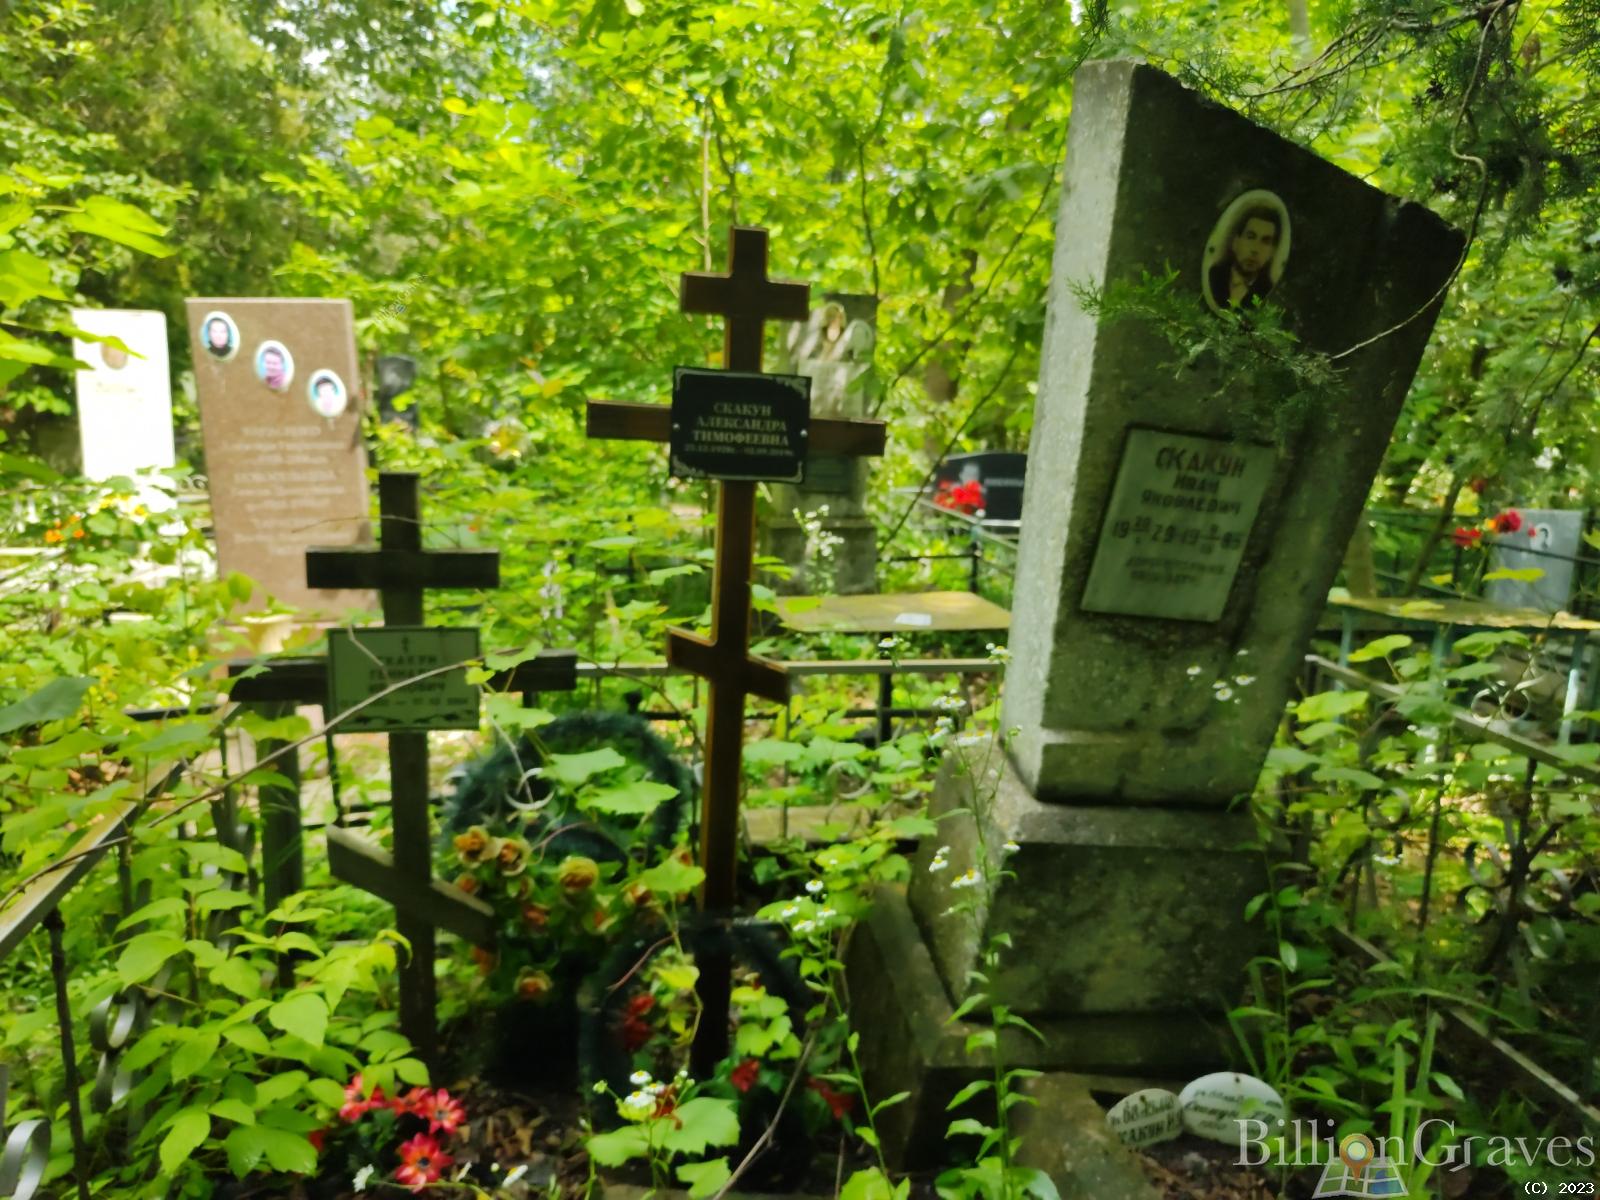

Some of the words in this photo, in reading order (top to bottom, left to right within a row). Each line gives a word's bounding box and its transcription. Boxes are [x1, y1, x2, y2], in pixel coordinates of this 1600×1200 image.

[713, 402, 772, 416] СКАКУН
[696, 416, 788, 432] АЛЕКСАНДРА
[692, 430, 789, 446] ТИМОФЕЕВНА
[1155, 447, 1247, 478] СКАКУН
[1173, 474, 1220, 495] ИВАН
[1141, 488, 1242, 516] ЯКОВЛЕВИЧ
